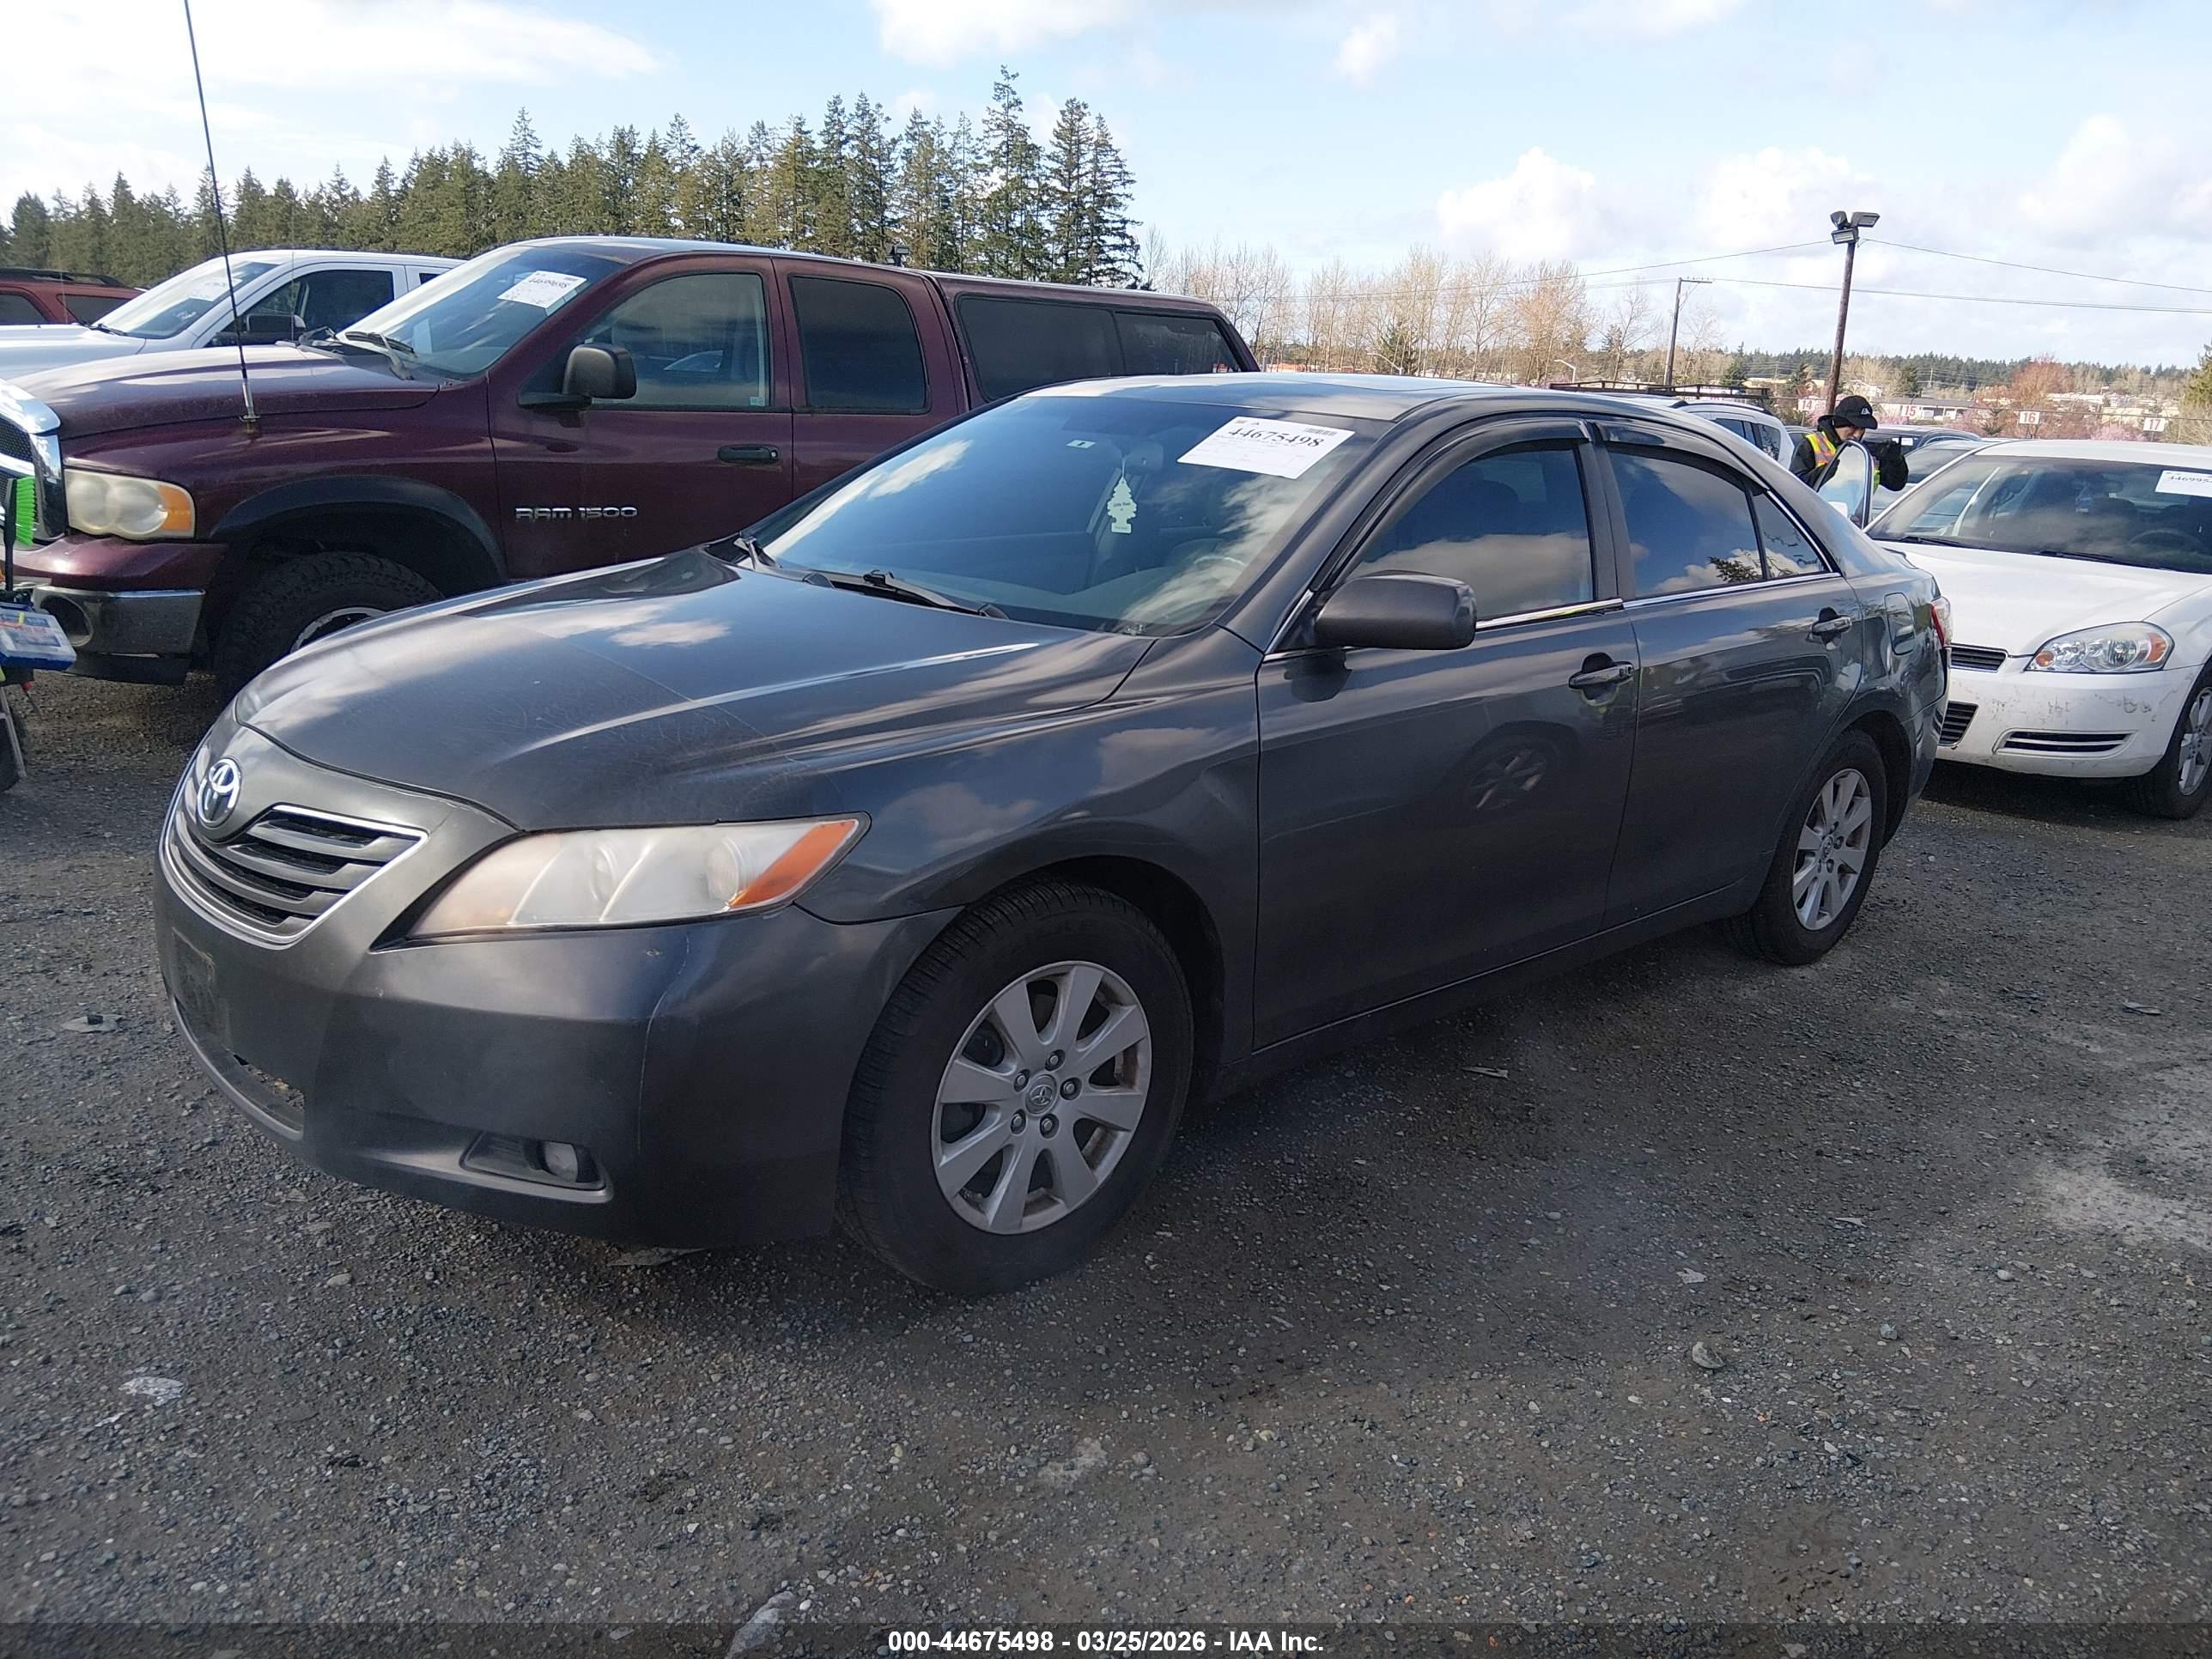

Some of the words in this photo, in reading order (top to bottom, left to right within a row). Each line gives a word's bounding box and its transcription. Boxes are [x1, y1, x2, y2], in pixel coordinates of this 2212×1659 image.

[1802, 400, 1813, 410] 14
[1905, 405, 1917, 416] 15
[2022, 411, 2036, 423] 16
[2149, 418, 2160, 430] 17
[1228, 427, 1325, 447] 44675498
[515, 507, 572, 520] RAM
[578, 507, 638, 519] 1500
